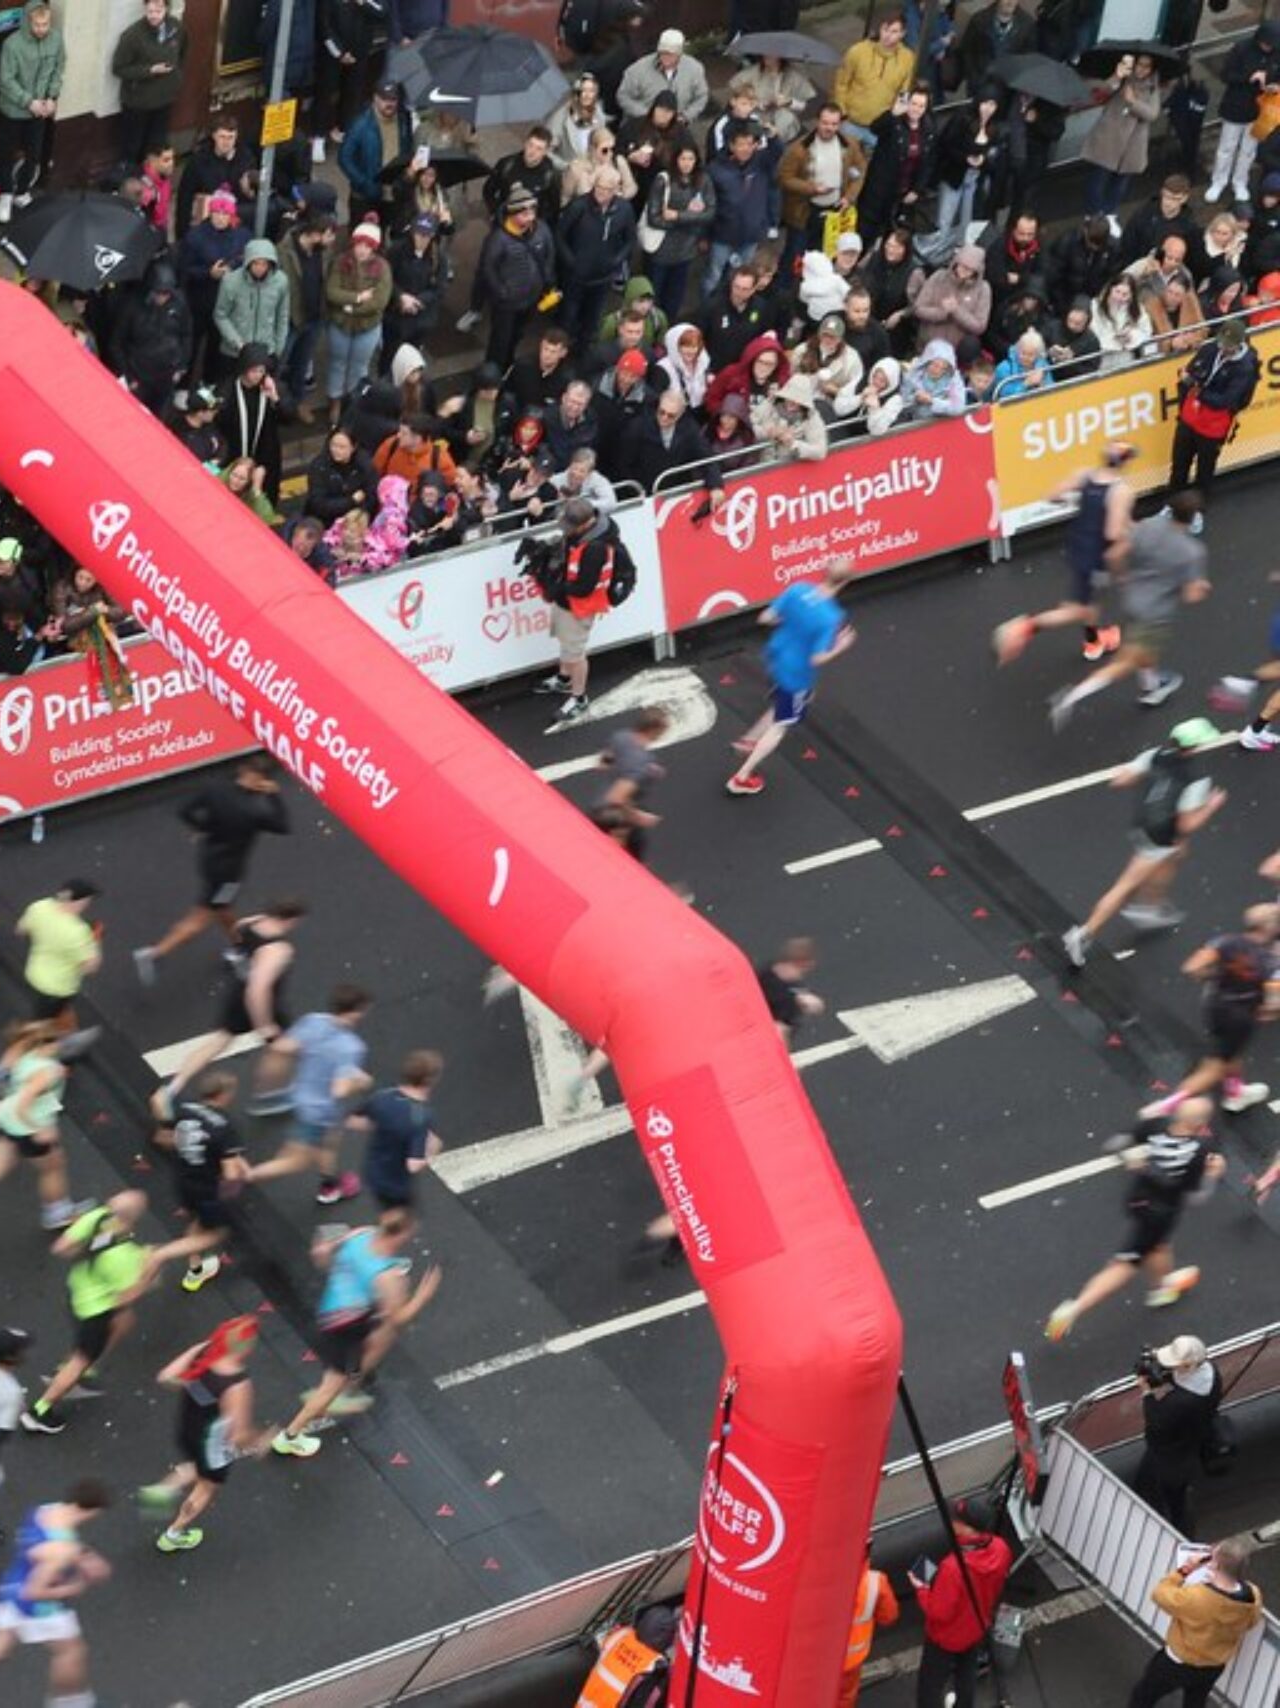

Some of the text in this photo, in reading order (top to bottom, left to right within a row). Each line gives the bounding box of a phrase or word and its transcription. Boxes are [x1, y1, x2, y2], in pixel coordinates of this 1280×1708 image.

[766, 455, 943, 530] Principality
[772, 518, 881, 561] Building Society
[859, 530, 919, 559] Adeiladu
[116, 531, 399, 809] Principality Building Society
[48, 718, 173, 764] Building Society
[53, 729, 215, 788] Cymdeithas Adeiladu
[251, 709, 327, 794] HALF
[658, 1142, 717, 1263] Principality
